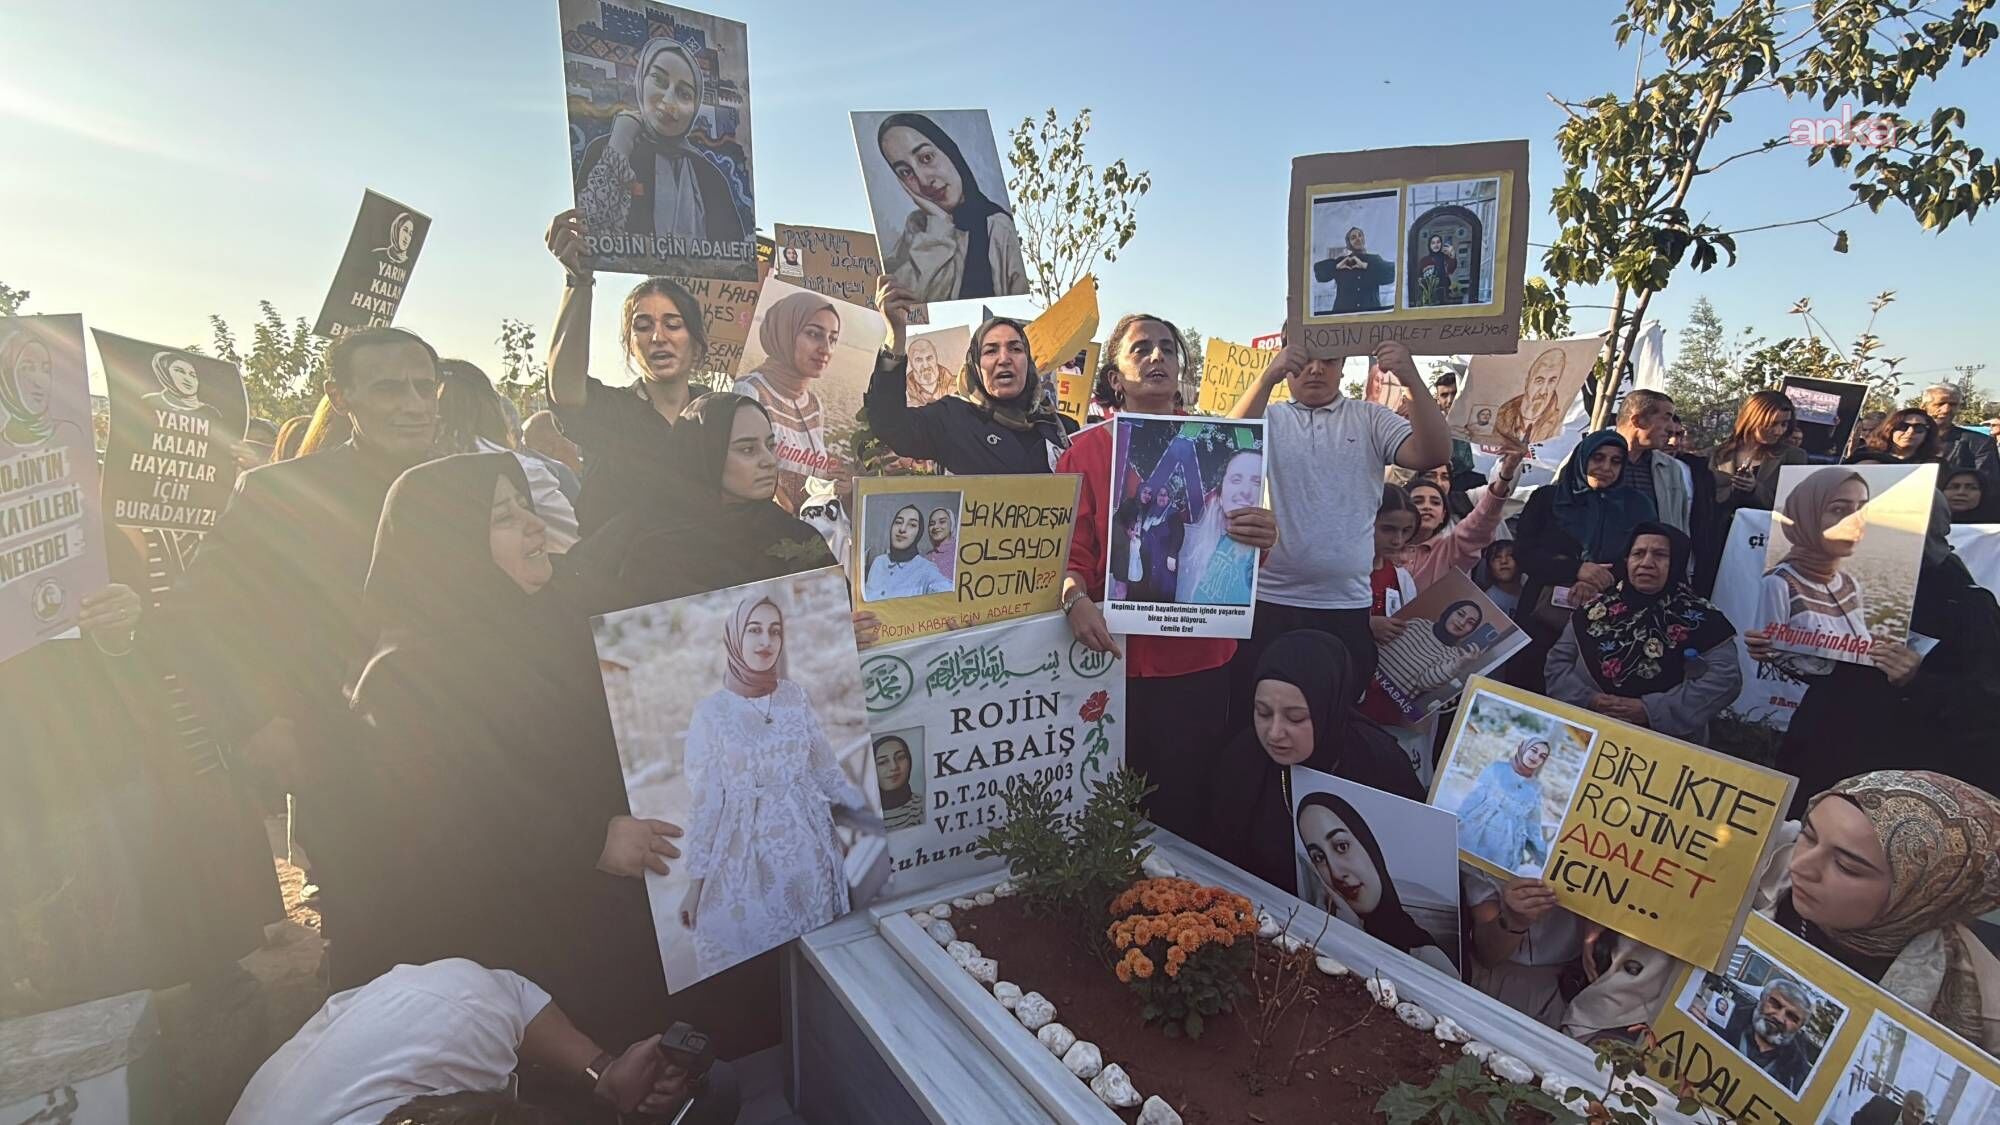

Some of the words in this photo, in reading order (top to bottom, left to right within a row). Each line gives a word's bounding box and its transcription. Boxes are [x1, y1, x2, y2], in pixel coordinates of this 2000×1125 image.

[584, 231, 645, 255] ROJİN
[650, 231, 685, 259] İÇİN
[691, 237, 755, 259] ADALET!
[1304, 324, 1363, 348] ROJİN
[1369, 325, 1432, 345] ADALET
[1439, 322, 1510, 341] BEKLİYOR
[155, 409, 210, 436] YARIM
[152, 432, 208, 458] KALAN
[0, 449, 65, 495] OJİN'İN
[130, 453, 217, 482] HAYATLAR
[153, 476, 190, 503] İÇİN
[115, 499, 217, 526] BURADAYIZ!
[991, 501, 1073, 530] KARDEŞİN
[959, 537, 1062, 566] OLSAYDI
[986, 602, 1032, 619] ADALET
[1111, 602, 1136, 612] Hepimiz
[1137, 604, 1155, 612] kendi
[1199, 606, 1218, 616] içinde
[1160, 624, 1181, 633] Cemile
[950, 690, 1061, 735] ROJİN
[933, 724, 1076, 779] KABAİŞ
[1575, 782, 1718, 861] ROJİNE
[1559, 823, 1717, 899] ADALET
